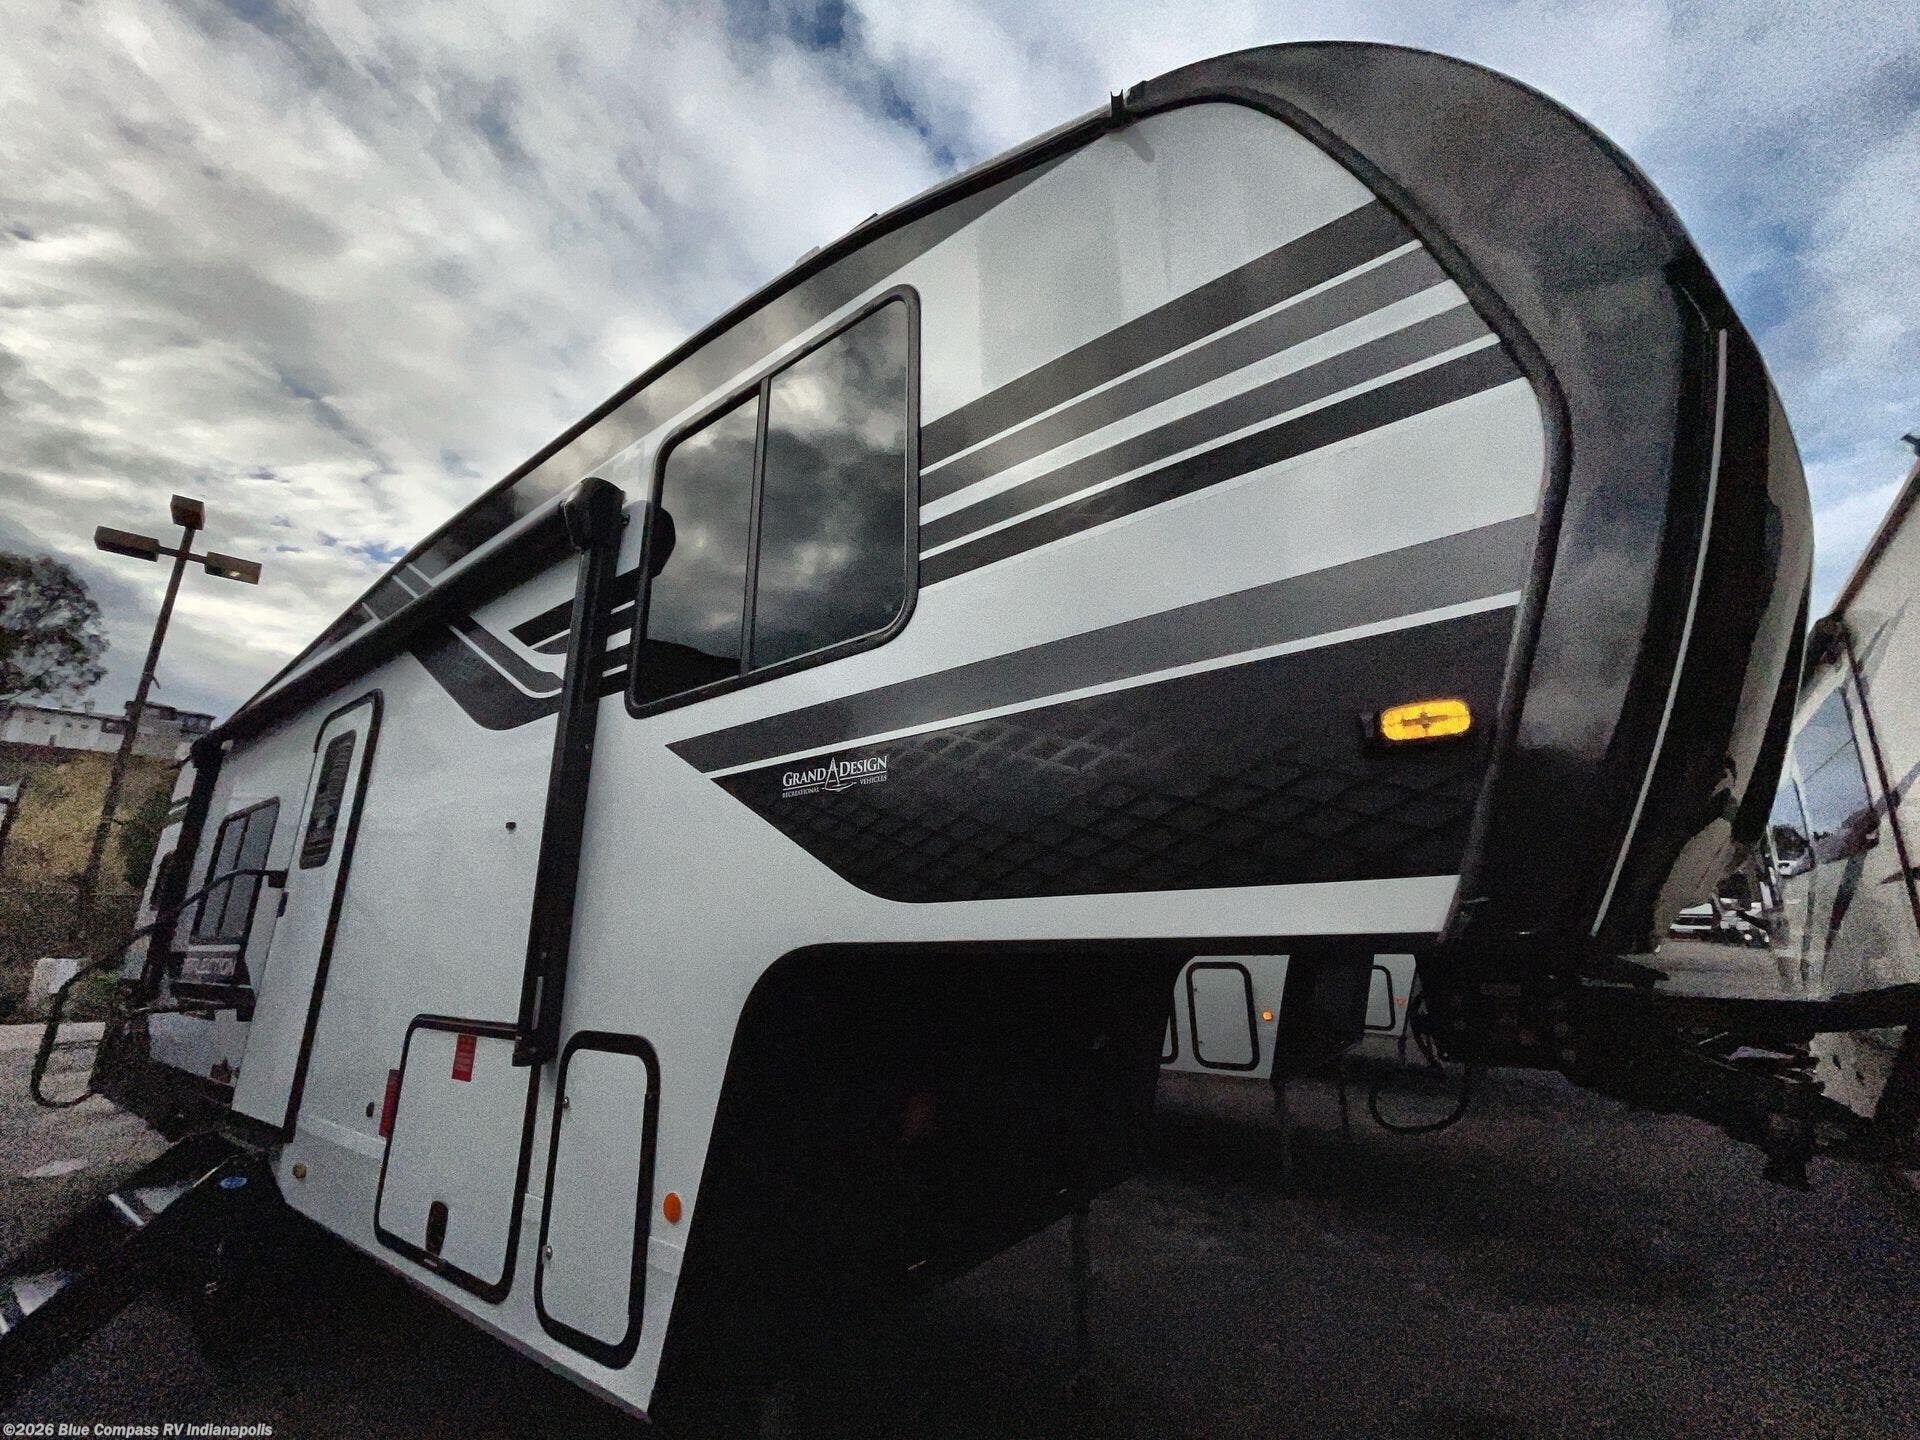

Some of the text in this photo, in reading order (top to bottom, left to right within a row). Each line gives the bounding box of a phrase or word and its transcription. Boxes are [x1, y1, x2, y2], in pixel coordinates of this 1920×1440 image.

[782, 755, 888, 787] GRAND DESIGN
[782, 774, 888, 799] RECREATIONAL VEHICLES
